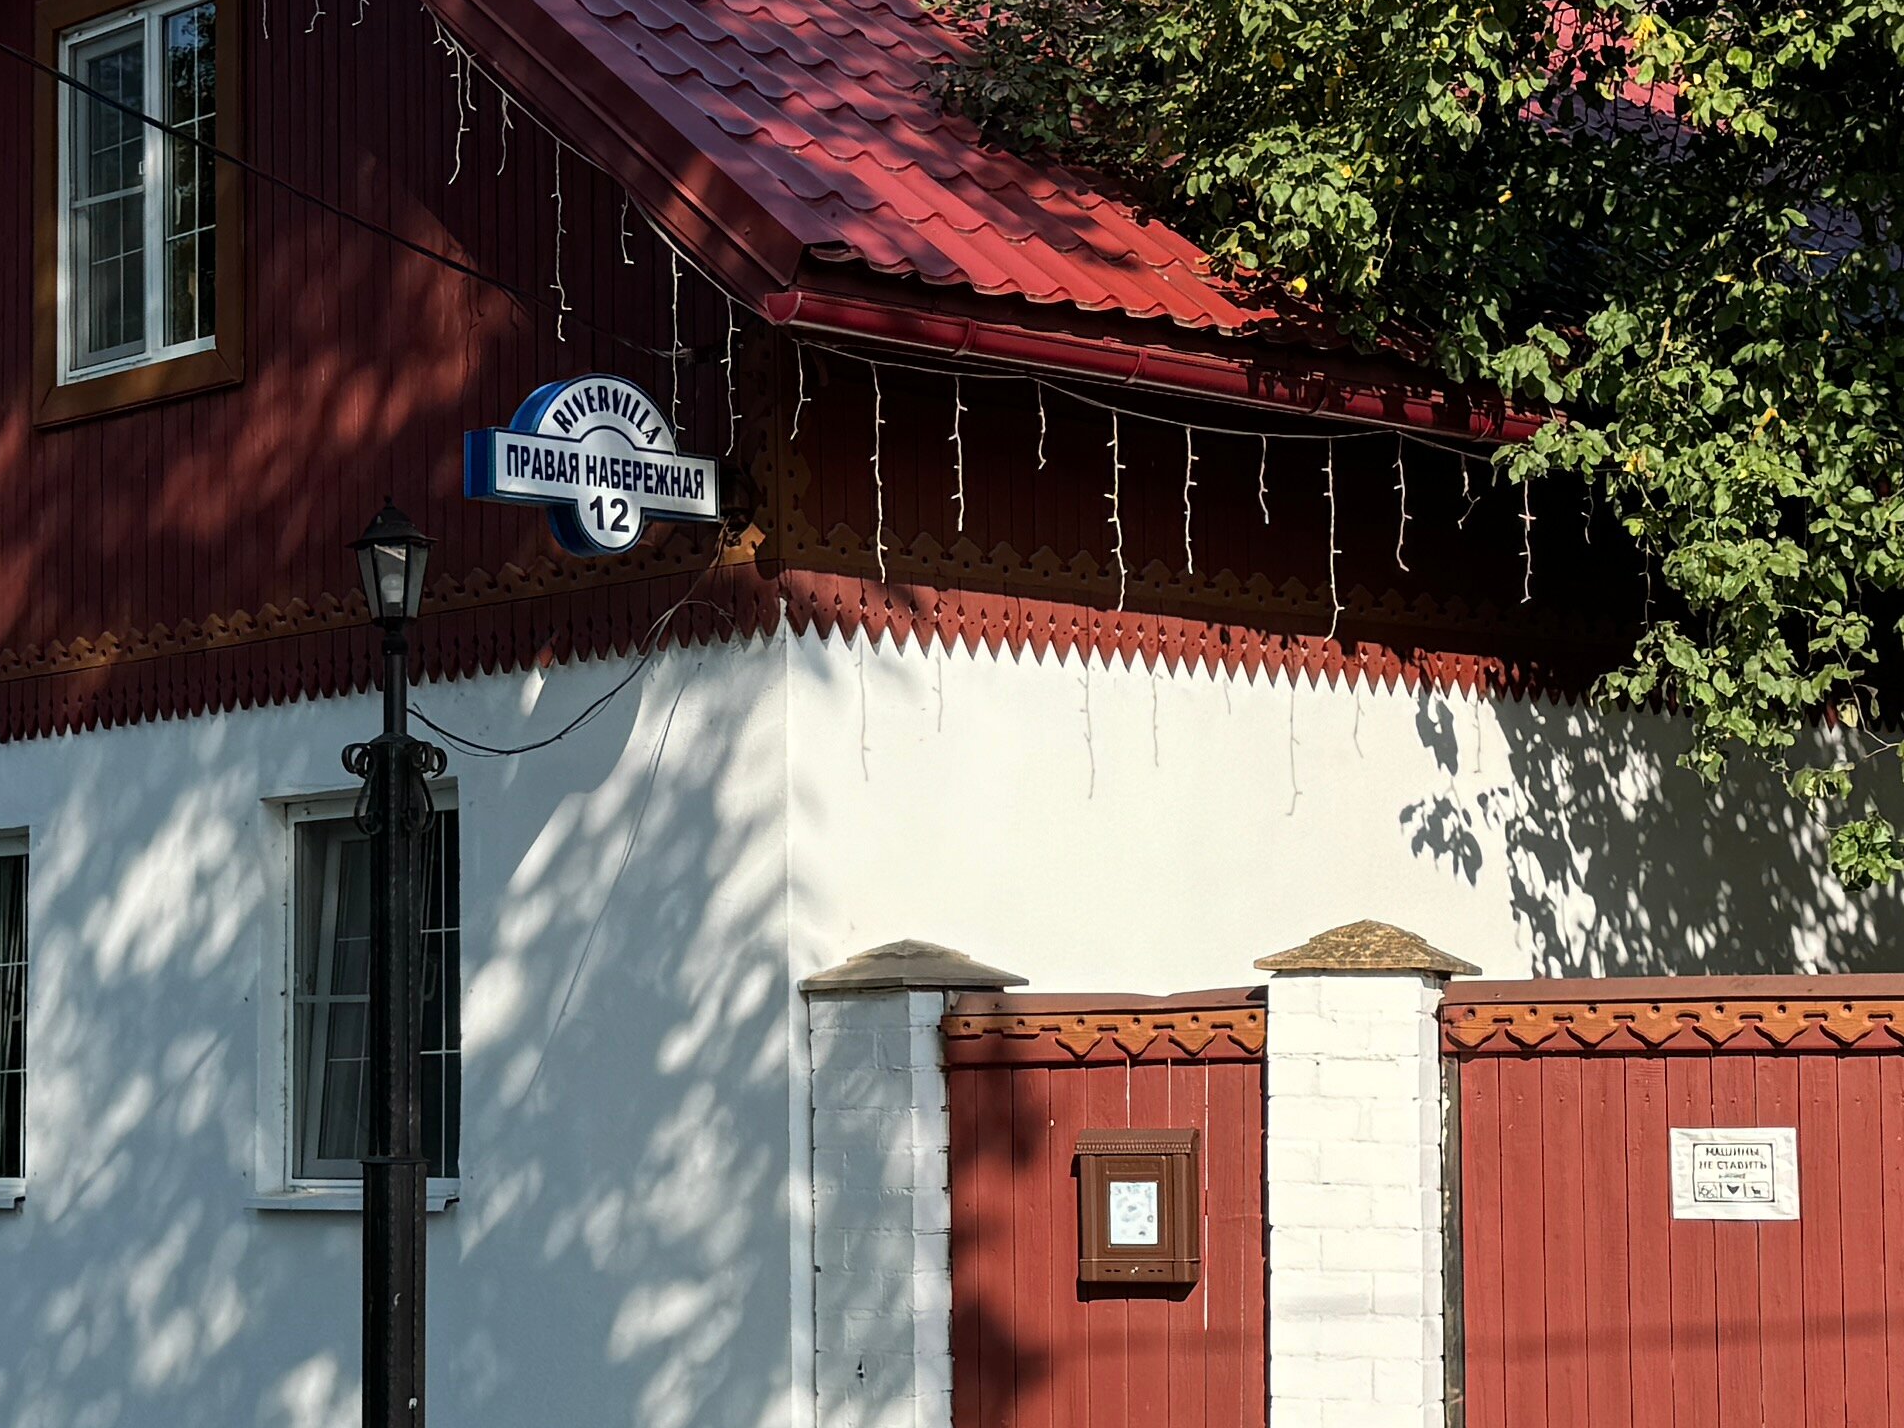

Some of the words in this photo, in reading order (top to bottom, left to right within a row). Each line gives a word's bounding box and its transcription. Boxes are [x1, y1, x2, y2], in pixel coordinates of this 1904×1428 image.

[552, 385, 662, 445] RIVERVILLA
[507, 443, 580, 486] ПРАВАЯ
[585, 454, 705, 501] НАБЕРЕЖНАЯ
[589, 495, 630, 533] 12
[1699, 1160, 1713, 1170] НЕ
[1716, 1160, 1768, 1170] СТАВИТЬ
[1705, 1147, 1760, 1157] МАШИНЫ
